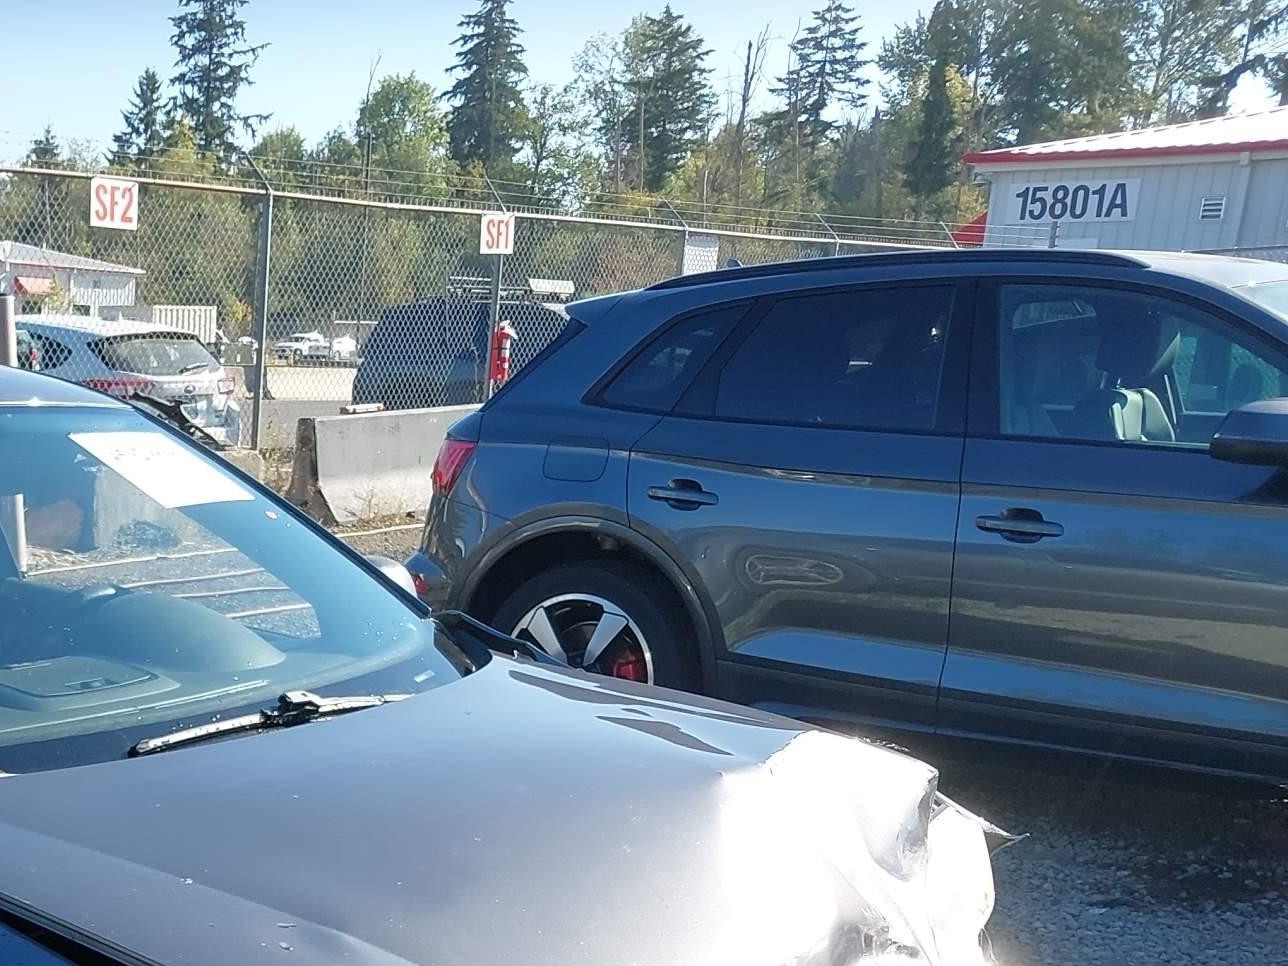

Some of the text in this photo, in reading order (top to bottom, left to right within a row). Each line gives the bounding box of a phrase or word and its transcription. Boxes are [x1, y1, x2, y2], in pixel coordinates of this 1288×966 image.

[95, 184, 133, 222] SF2
[1015, 182, 1128, 221] 15801A
[486, 219, 510, 249] SF1
